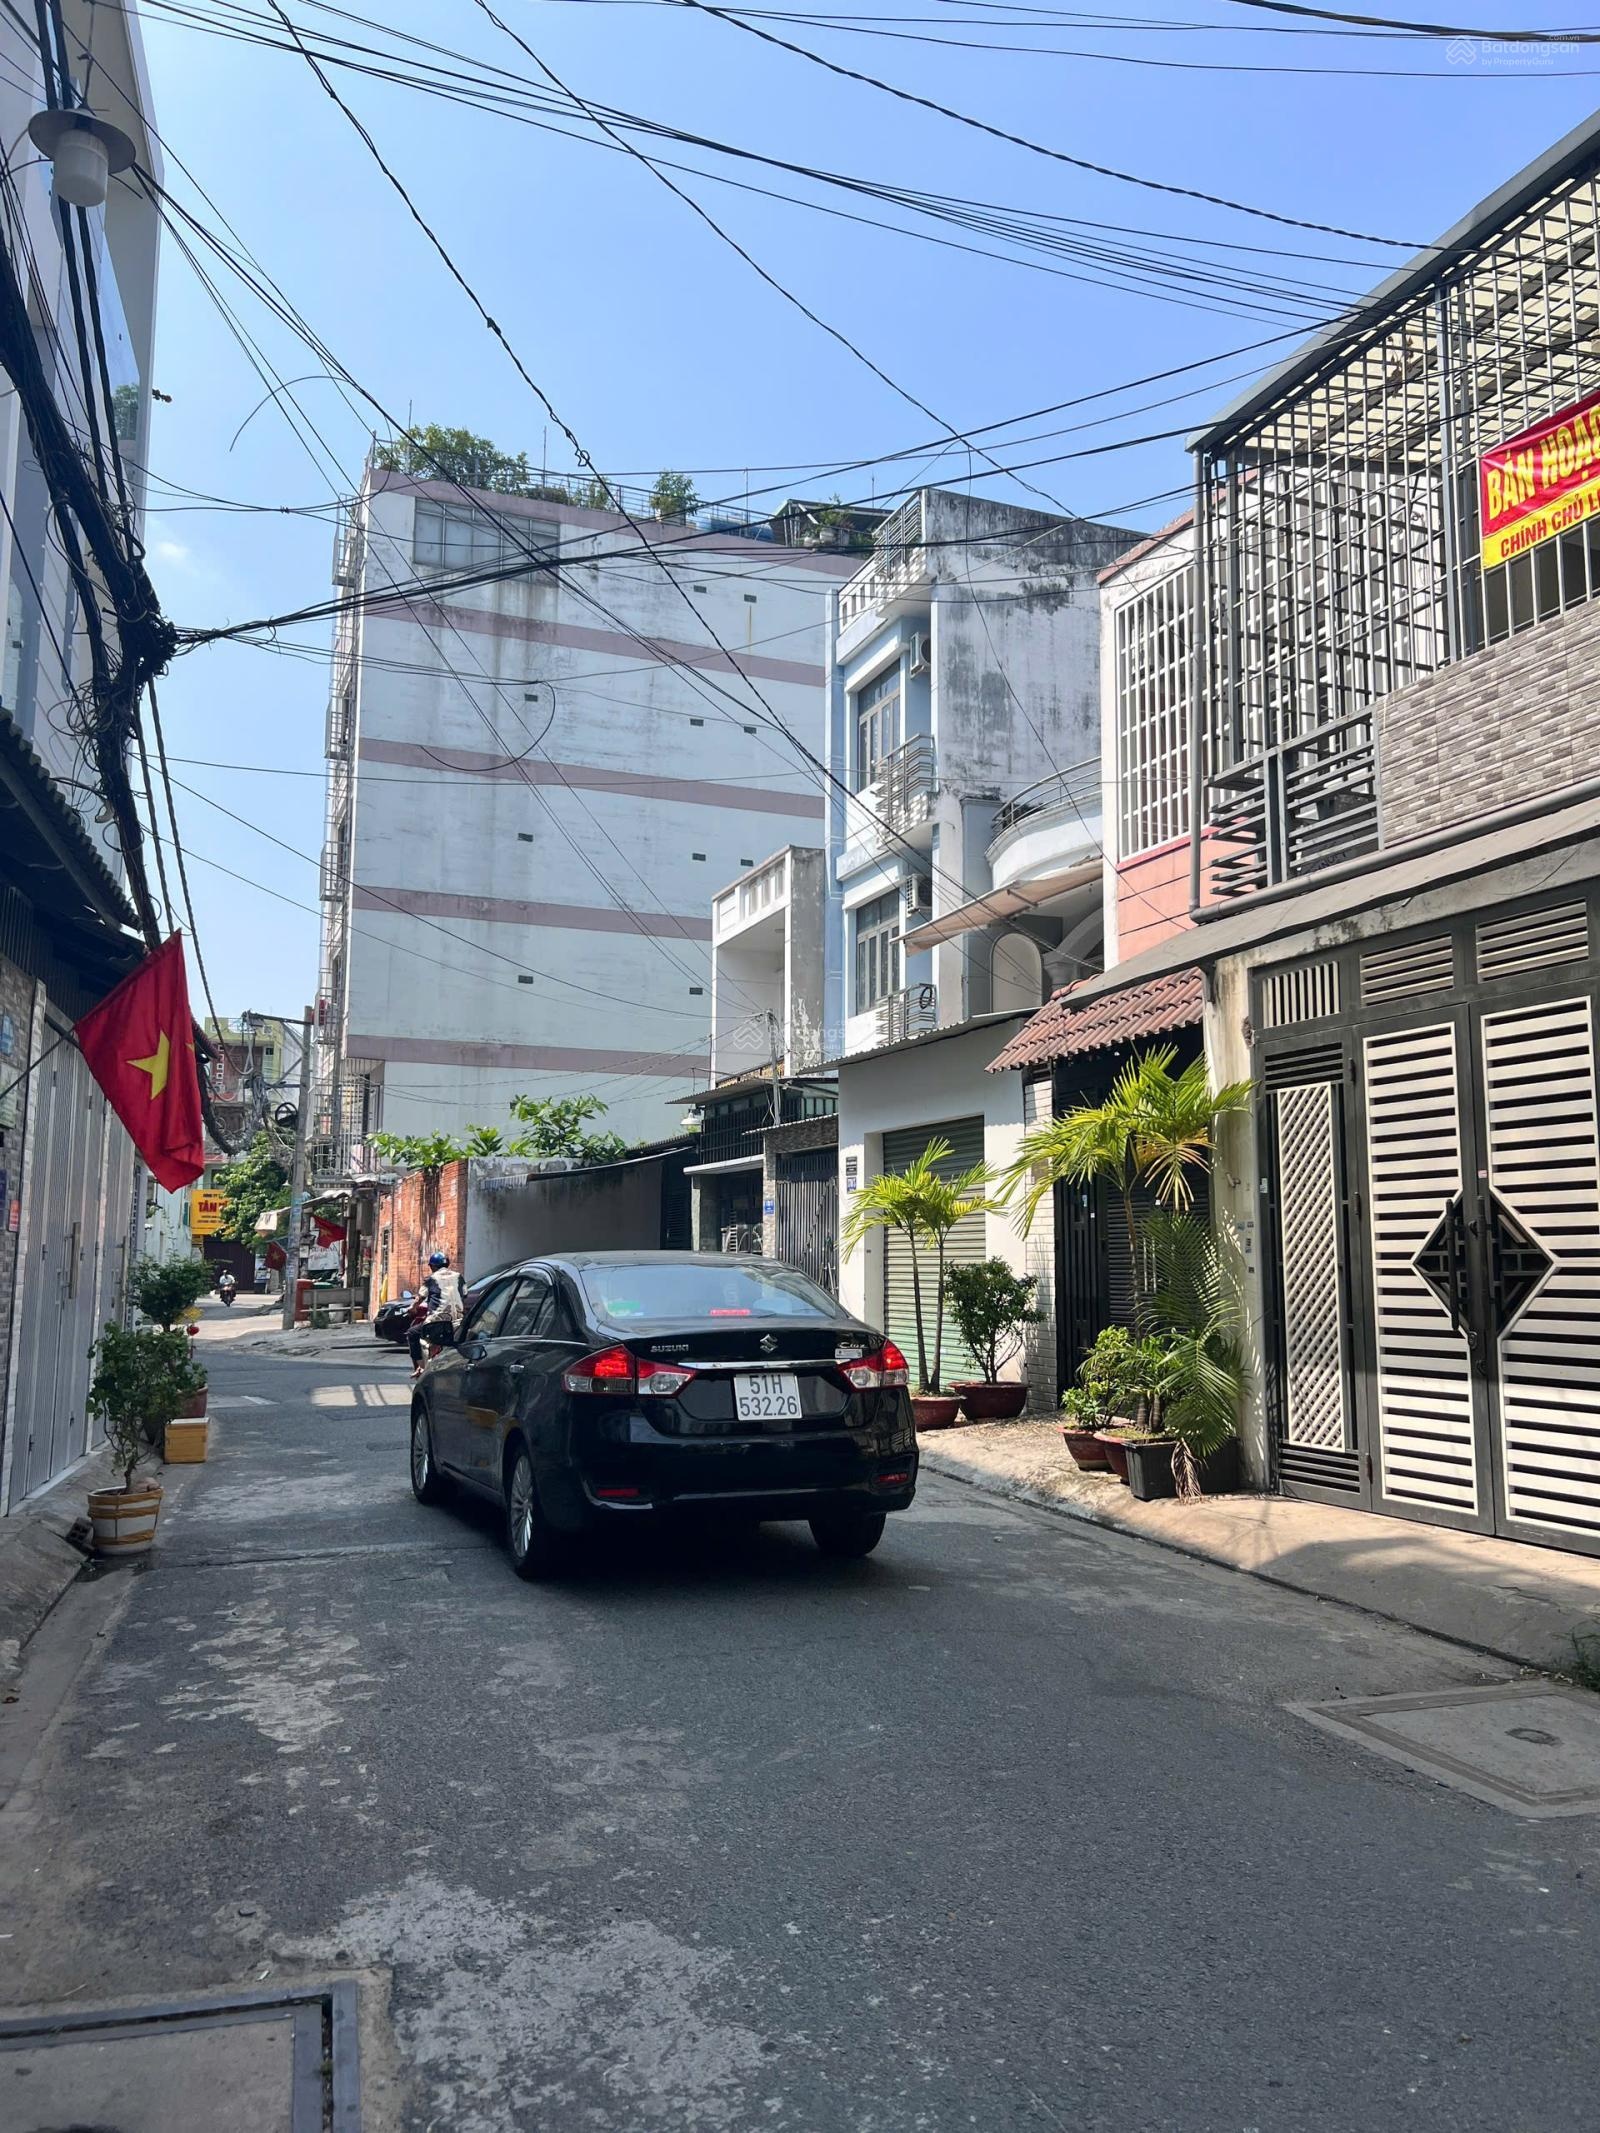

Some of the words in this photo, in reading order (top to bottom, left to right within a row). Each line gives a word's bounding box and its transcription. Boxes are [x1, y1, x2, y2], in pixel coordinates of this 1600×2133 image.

[1487, 448, 1535, 520] BÁN
[1501, 517, 1547, 558] CHÍNH
[1552, 493, 1583, 531] CHỦ
[651, 1344, 689, 1352] SUZUKI
[749, 1374, 783, 1394] 51H
[739, 1396, 798, 1416] 532.26
